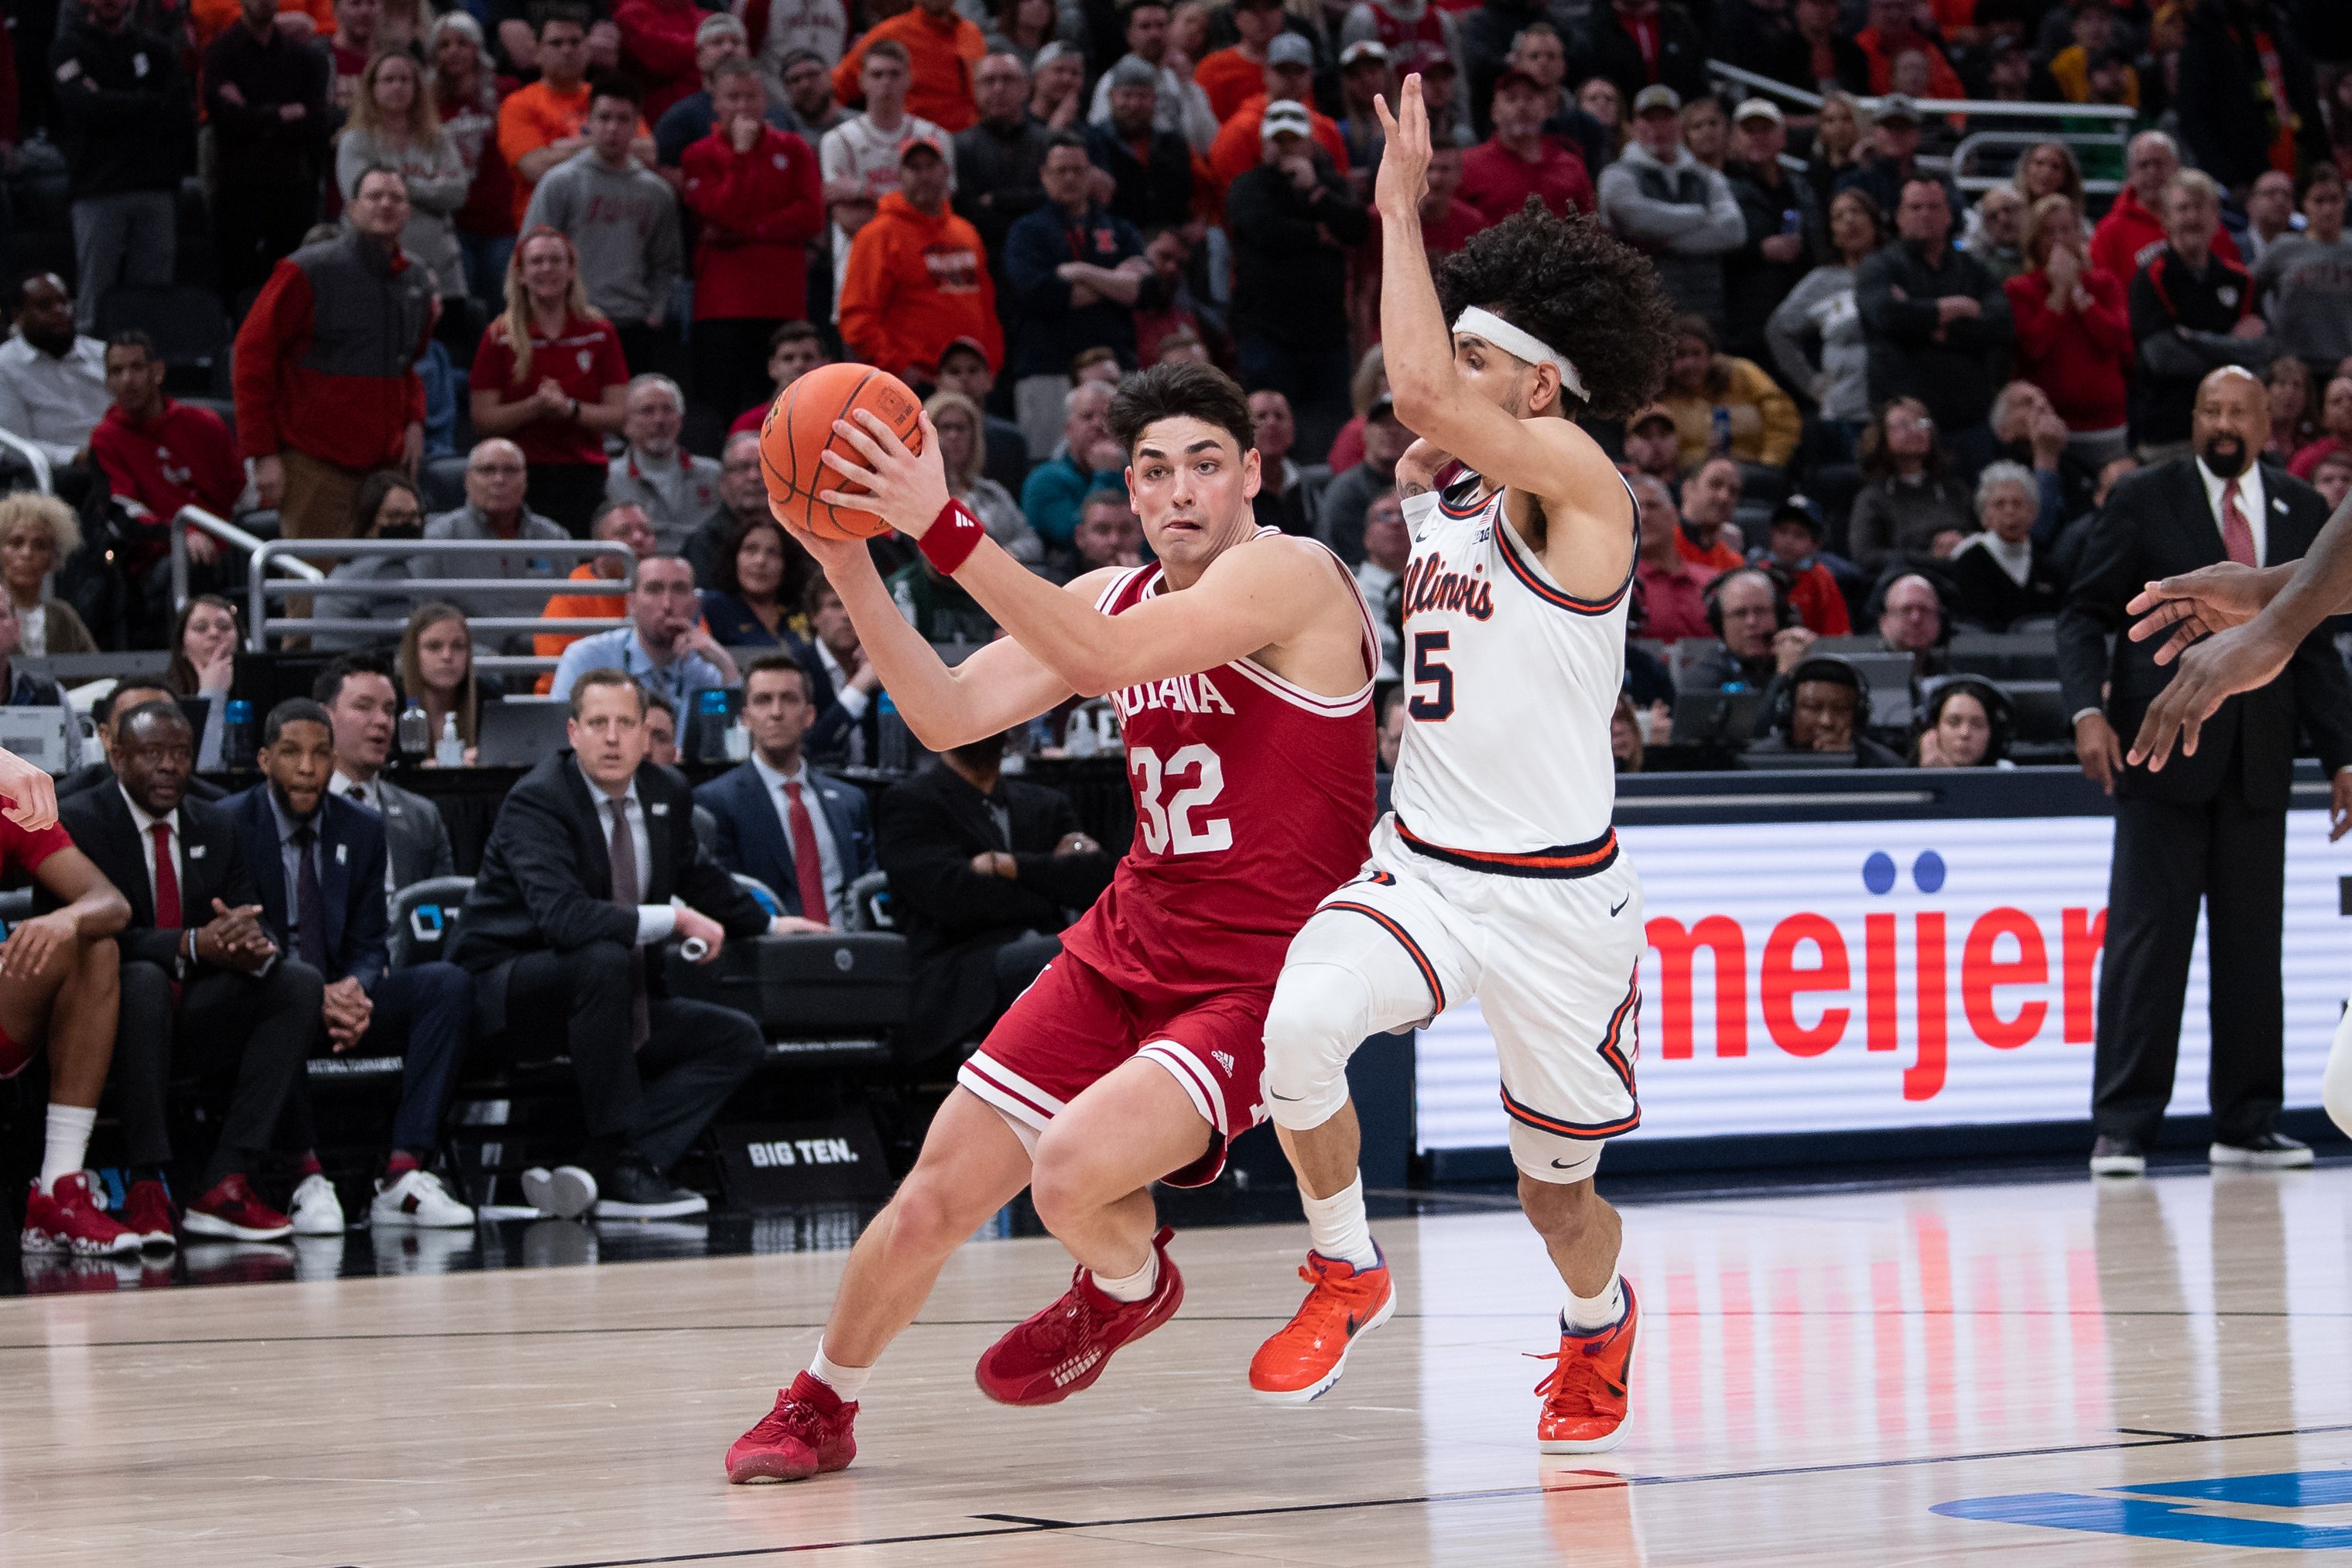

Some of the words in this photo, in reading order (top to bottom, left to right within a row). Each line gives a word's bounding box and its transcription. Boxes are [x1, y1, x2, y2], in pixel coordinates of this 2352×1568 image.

[1107, 673, 1235, 731] NDIANA
[1408, 630, 1455, 722] 5
[1130, 742, 1234, 855] 32
[1645, 850, 2109, 1101] meijer
[1210, 1050, 1233, 1079] adidas
[748, 1141, 796, 1167] BIG
[795, 1138, 859, 1164] TEN.
